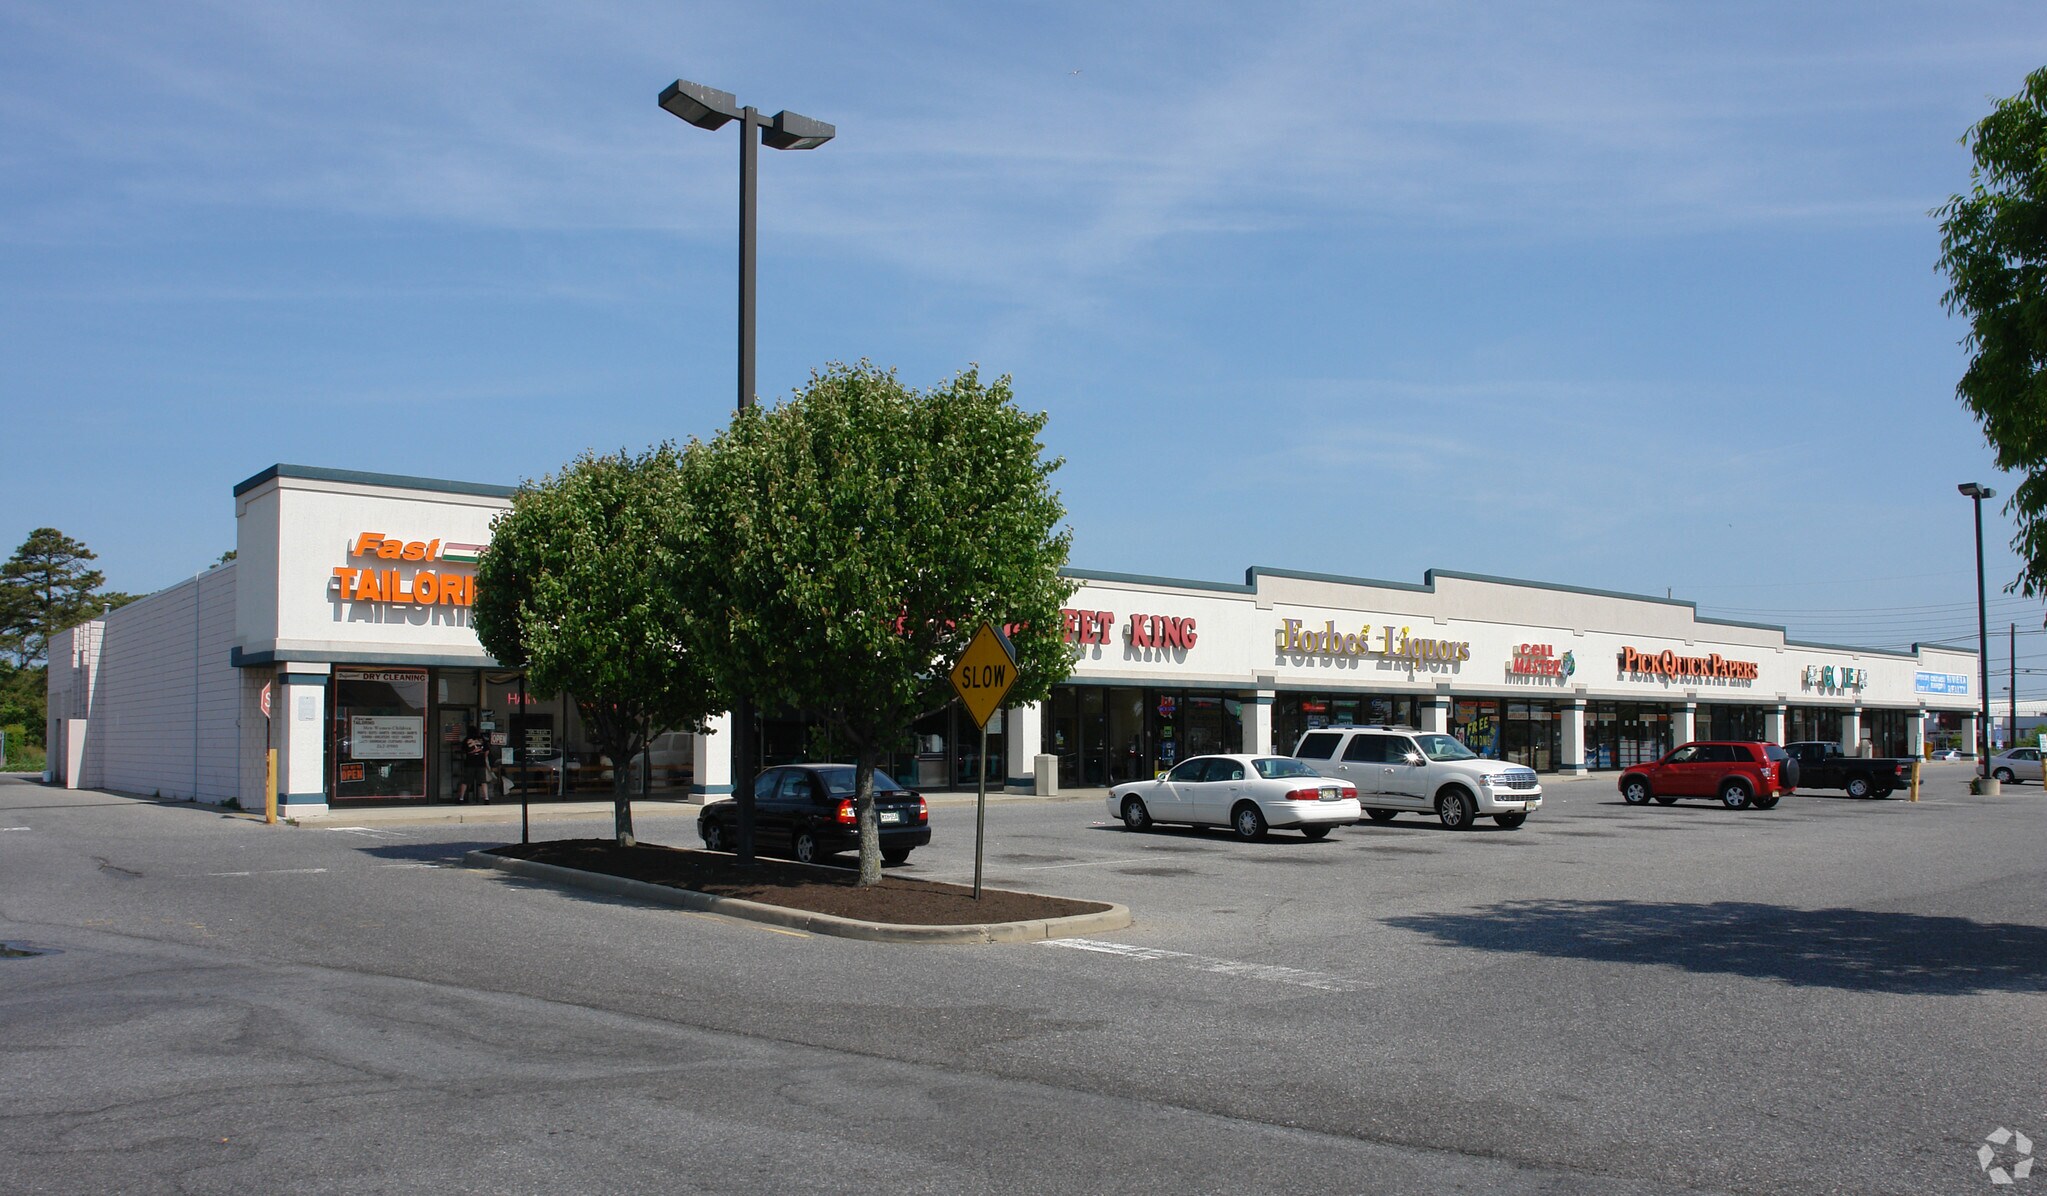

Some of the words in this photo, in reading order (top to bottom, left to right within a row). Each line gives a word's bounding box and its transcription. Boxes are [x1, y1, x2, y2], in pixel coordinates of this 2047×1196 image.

[352, 532, 441, 562] Fast
[333, 566, 477, 607] TAILORI
[1130, 613, 1198, 650] KING
[1383, 625, 1471, 673] Liquors
[383, 673, 426, 682] CLEANING
[962, 664, 1006, 689] SLOW
[1513, 657, 1562, 677] MASTER
[1467, 716, 1489, 736] FREE
[342, 769, 363, 781] OPEN
